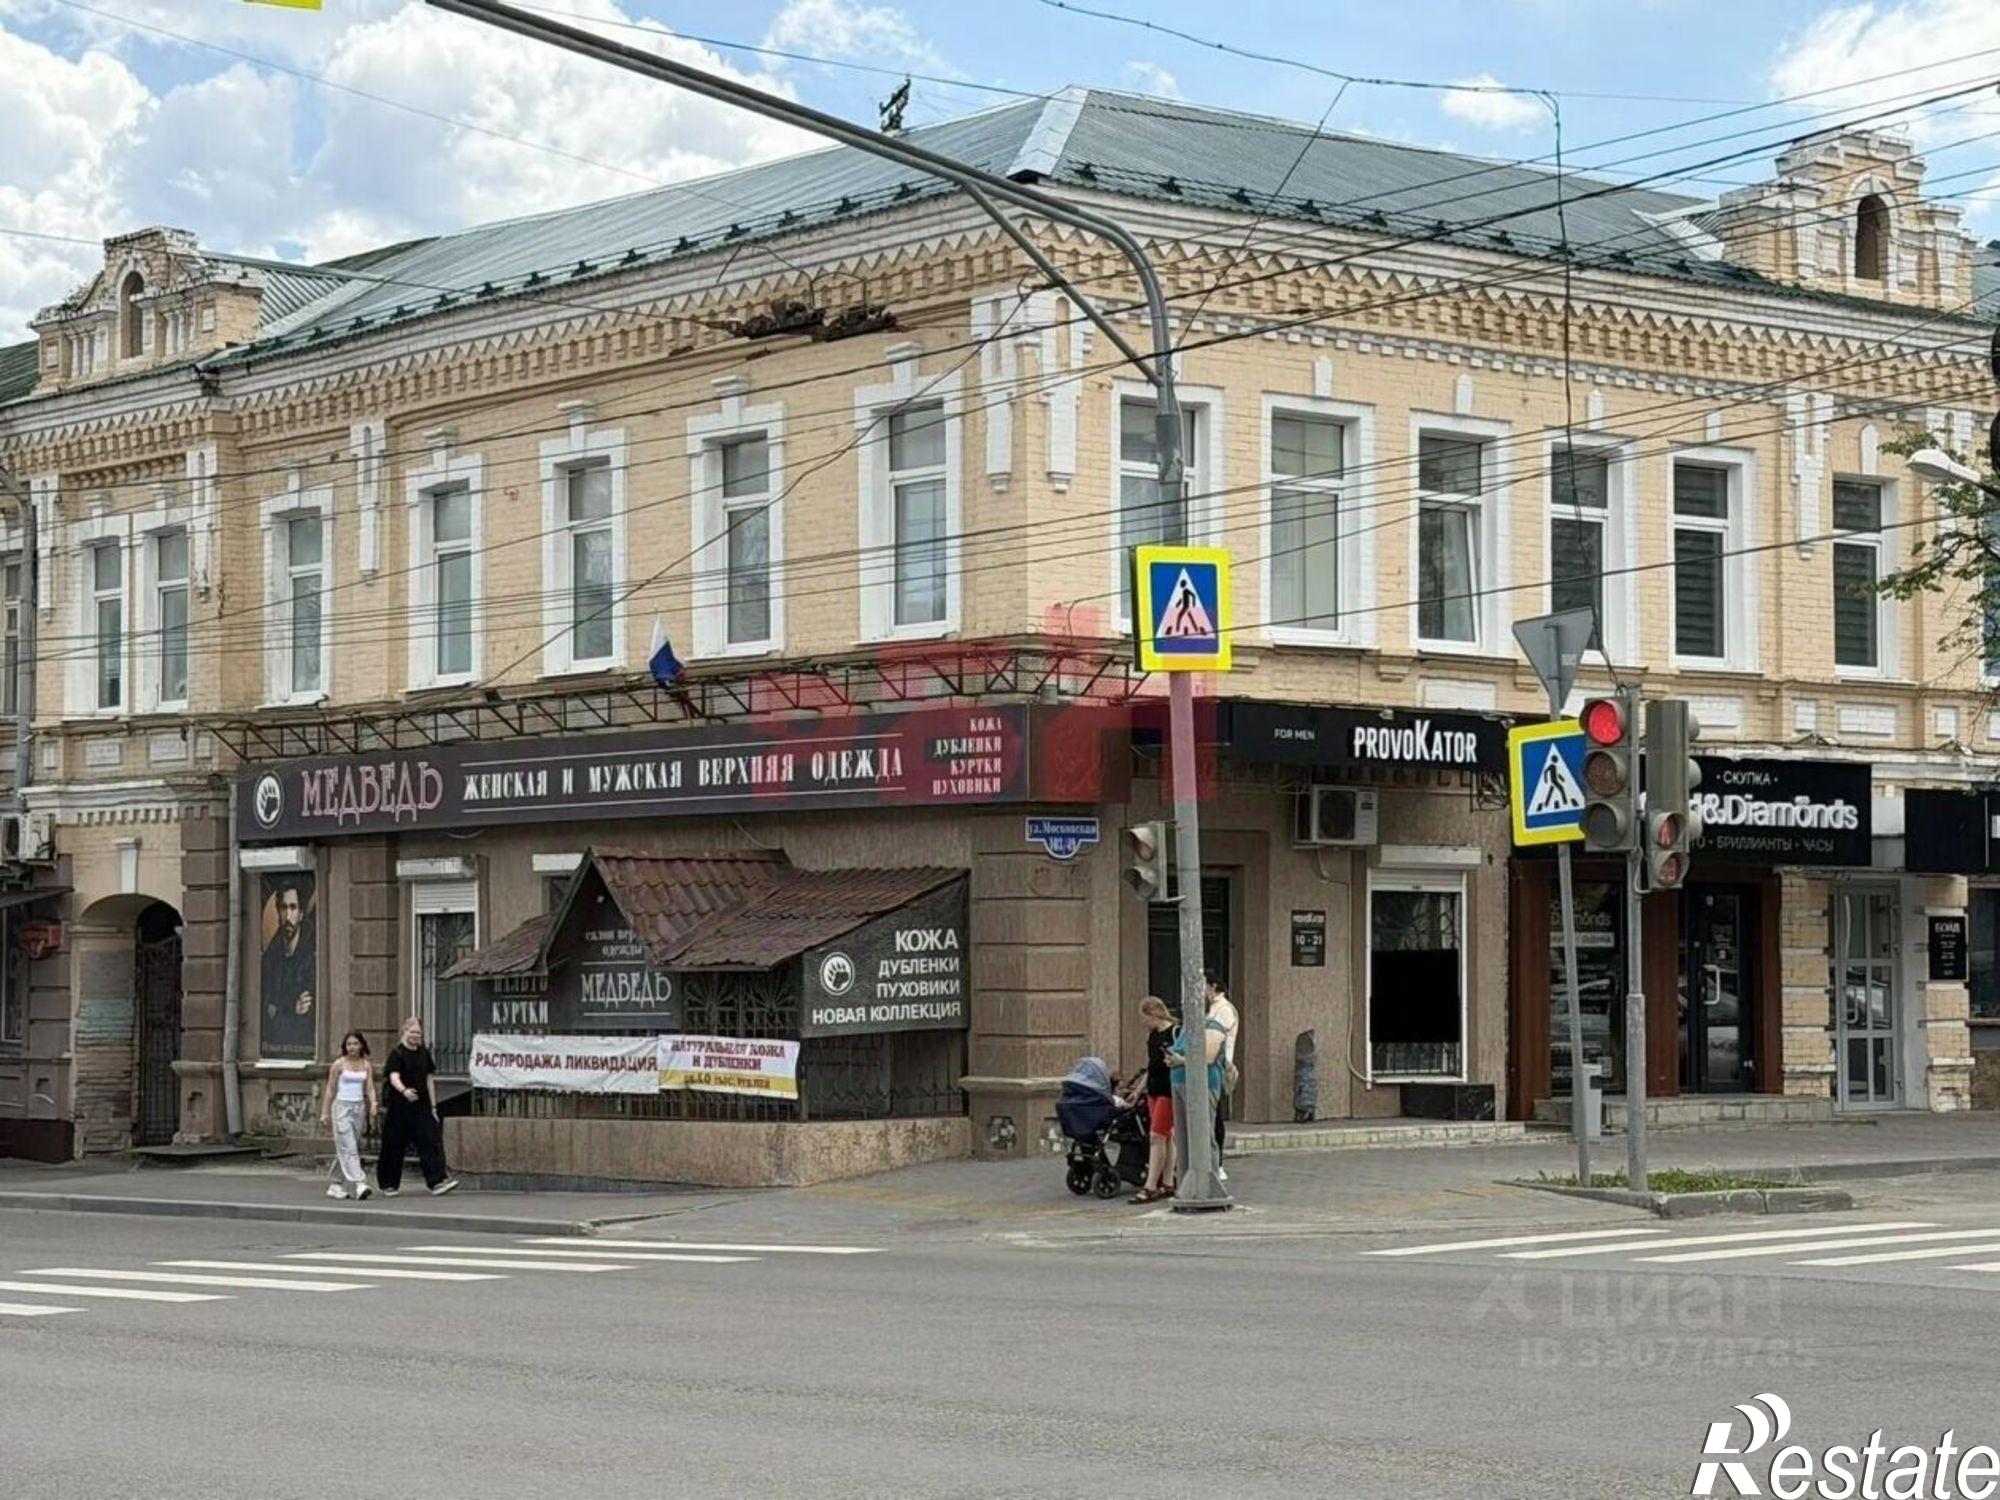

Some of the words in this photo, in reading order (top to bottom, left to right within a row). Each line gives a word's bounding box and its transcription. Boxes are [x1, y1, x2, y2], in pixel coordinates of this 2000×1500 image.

[970, 717, 1002, 732] КОЖА
[1274, 728, 1292, 740] FOR
[1295, 729, 1315, 741] MEN
[933, 736, 1002, 757] ДУБЛЕНКИ
[1353, 719, 1478, 763] PROVOKATOR
[463, 769, 548, 800] ЖЕНСКАЯ
[562, 767, 574, 795] И
[588, 760, 682, 793] МУЖСКАЯ
[699, 754, 795, 786] ВЕРХНЯЯ
[812, 747, 903, 787] ОДЕЖДА
[950, 757, 1002, 775] КУРТКИ
[932, 777, 1001, 796] ПУХОВИКИ
[1723, 770, 1771, 785] СКУПКА
[301, 761, 443, 826] МЕДВЕДЬ
[1716, 836, 1793, 851] БРИЛЛИАНТЫ
[1802, 839, 1835, 852] ЧАСЫ
[895, 928, 959, 952] КОЖА
[1296, 935, 1306, 945] 10
[879, 957, 960, 978] ДУБЛЕНКИ
[581, 970, 672, 1009] МЕДВЕДЬ
[877, 979, 960, 998] ПУХОВИКИ
[492, 1001, 549, 1025] КУРТКИ
[812, 1006, 866, 1025] НОВАЯ
[870, 1002, 961, 1021] КОЛЛЕКЦИЯ
[749, 1044, 785, 1058] КОЖА
[475, 1052, 561, 1071] РАСПРОДАЖА
[565, 1055, 658, 1073] ЛИКВИДАЦИЯ
[692, 1055, 701, 1067] И
[704, 1056, 762, 1071] ДУБЛЕНКИ
